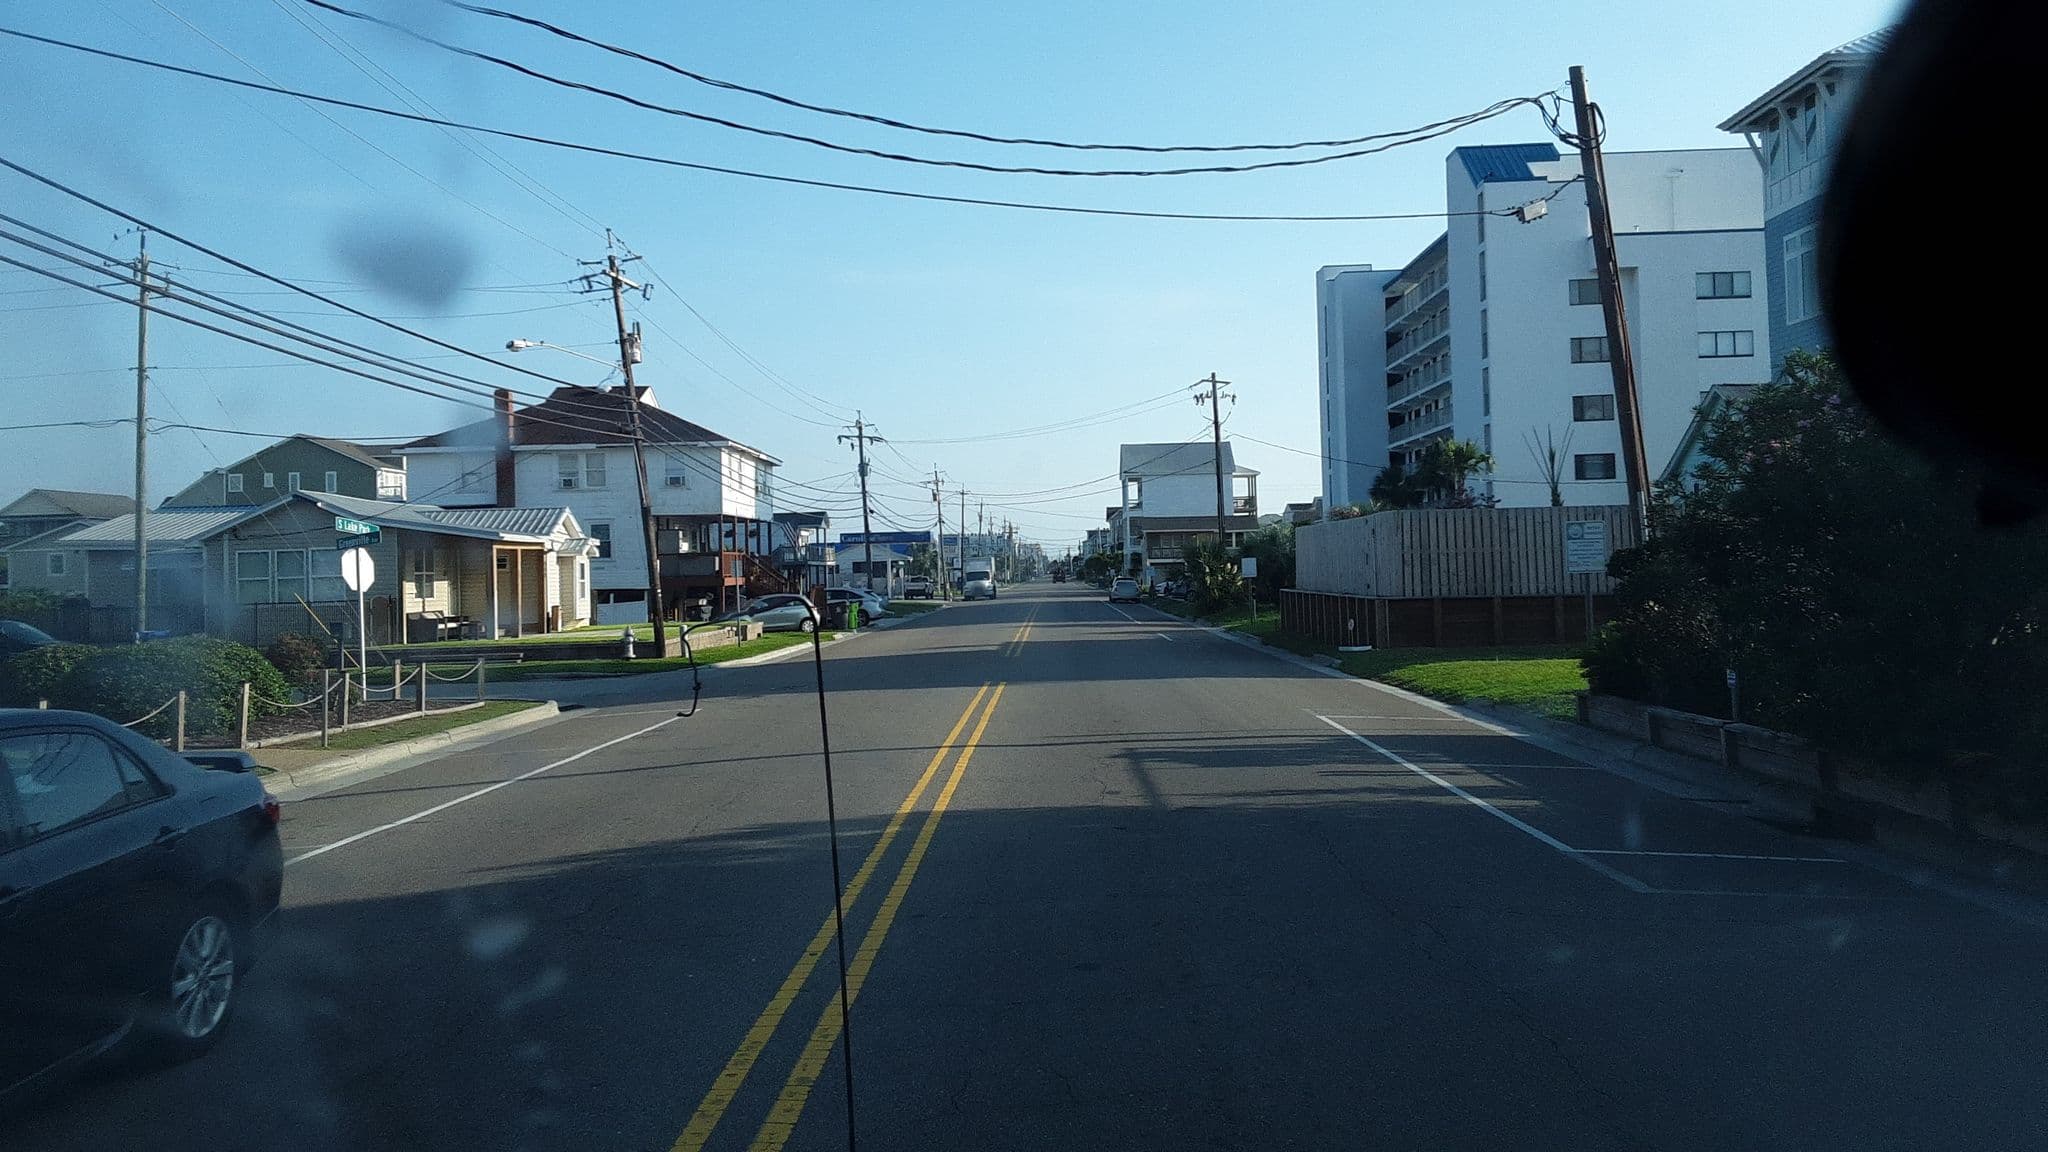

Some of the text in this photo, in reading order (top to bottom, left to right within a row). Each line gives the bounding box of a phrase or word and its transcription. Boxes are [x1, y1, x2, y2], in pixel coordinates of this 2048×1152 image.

[338, 519, 370, 533] S Lake Park
